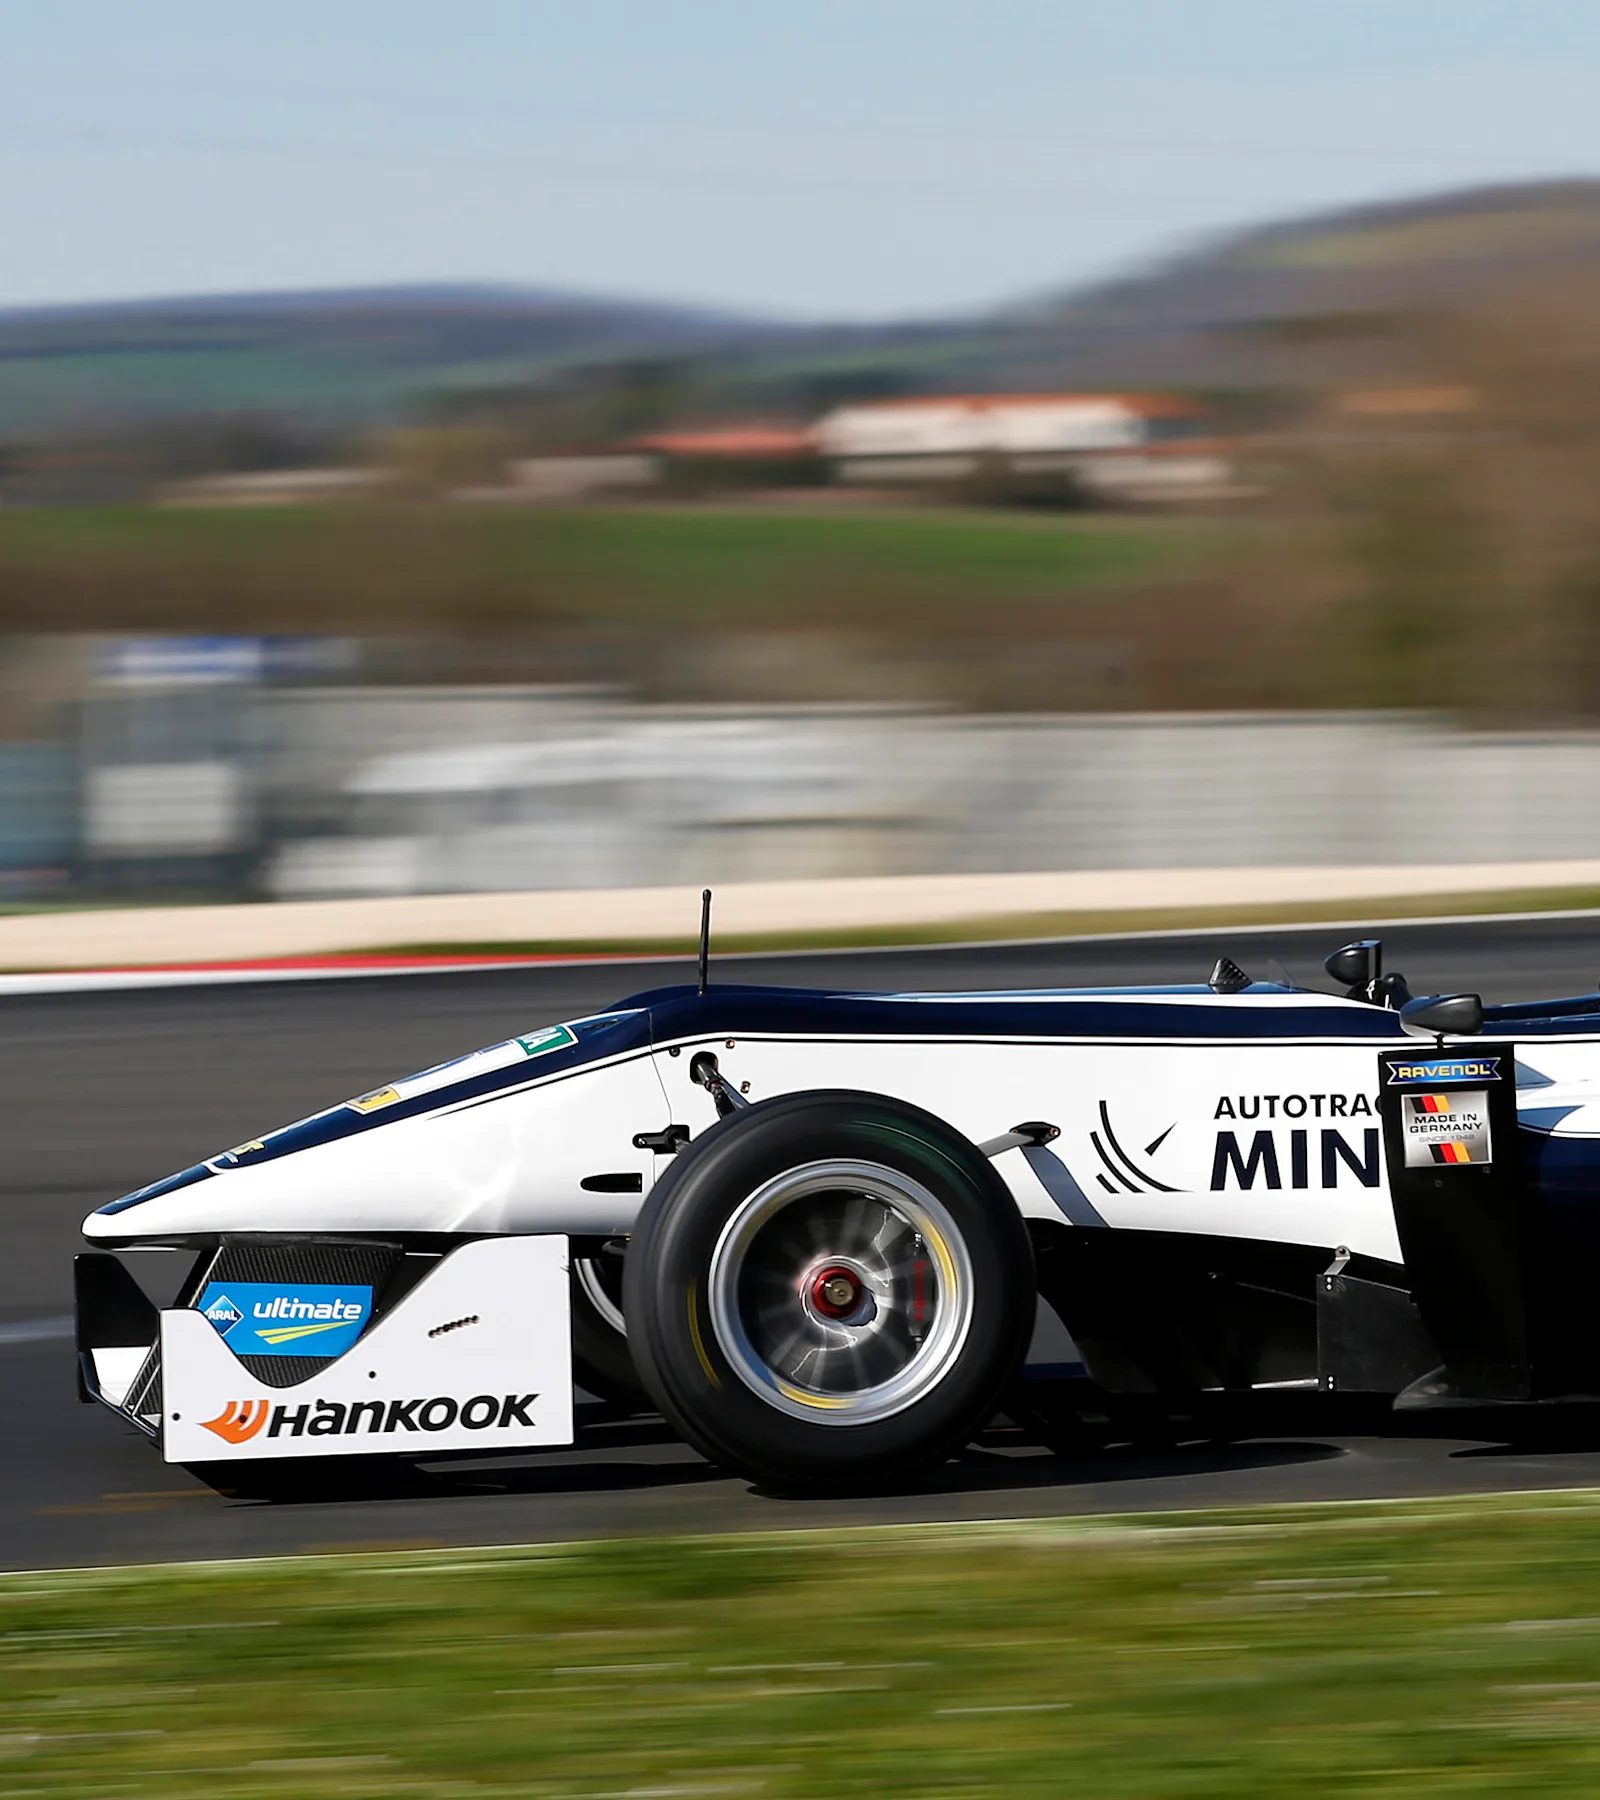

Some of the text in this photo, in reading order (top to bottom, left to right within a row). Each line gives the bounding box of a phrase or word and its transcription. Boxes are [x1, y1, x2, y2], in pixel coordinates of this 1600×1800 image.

[1398, 1063, 1492, 1079] RAVENOL
[1414, 1112, 1478, 1125] MADE IN
[1409, 1121, 1483, 1134] GERMANY
[208, 1297, 363, 1321] ARAL ultimate
